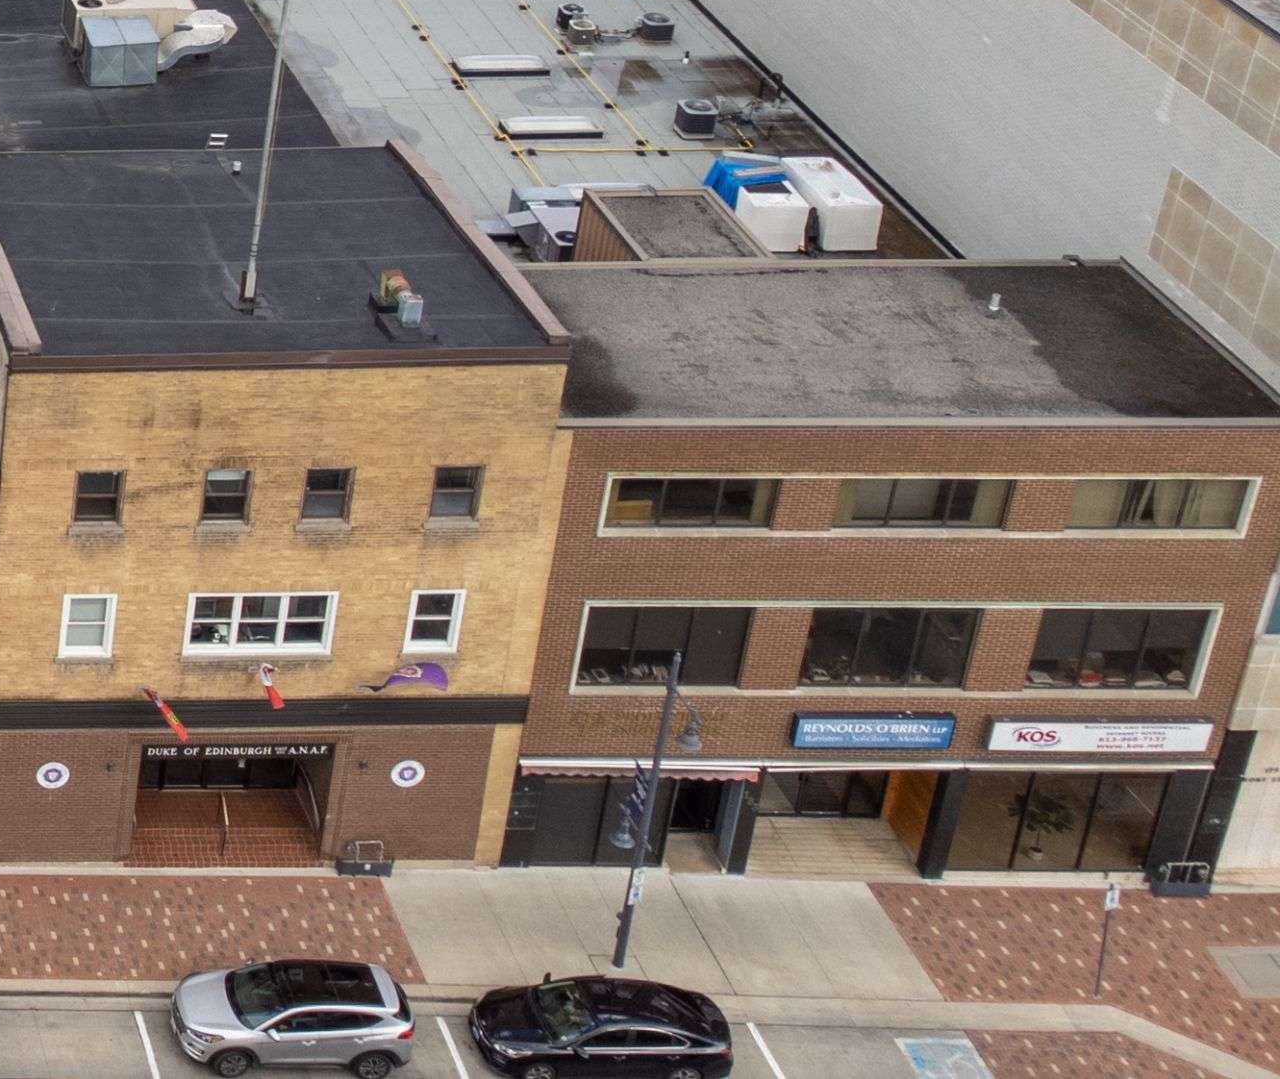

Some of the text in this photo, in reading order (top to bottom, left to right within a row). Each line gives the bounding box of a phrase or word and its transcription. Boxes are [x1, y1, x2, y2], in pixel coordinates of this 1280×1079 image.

[803, 723, 873, 734] REYNOLDS
[876, 723, 930, 734] O'BRIEN
[1017, 730, 1057, 743] KOS
[147, 747, 178, 756] DUKE
[184, 747, 200, 756] OF
[205, 746, 272, 756] EDINBURGH
